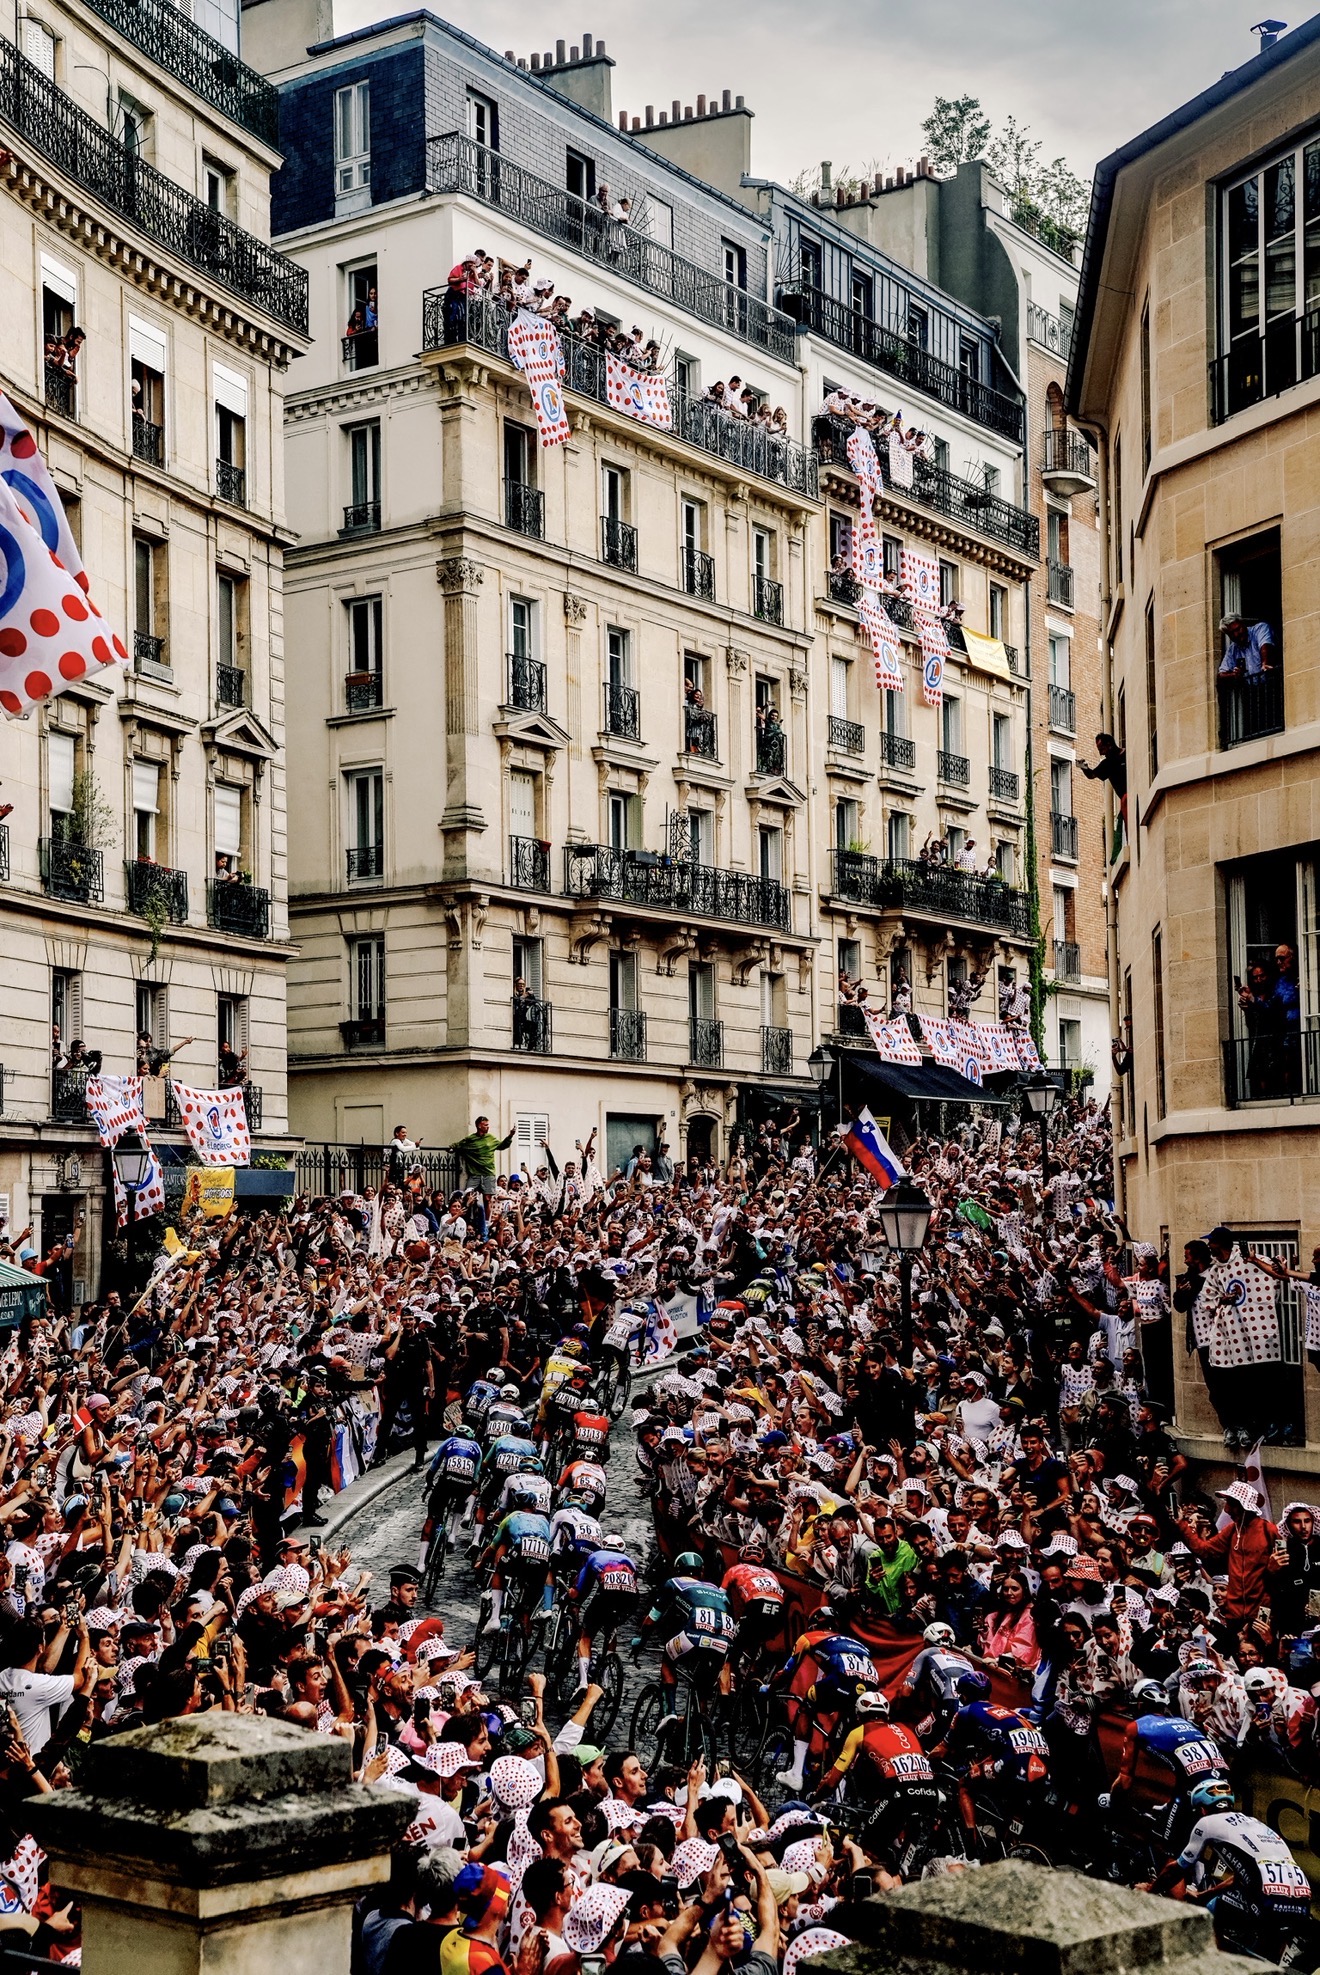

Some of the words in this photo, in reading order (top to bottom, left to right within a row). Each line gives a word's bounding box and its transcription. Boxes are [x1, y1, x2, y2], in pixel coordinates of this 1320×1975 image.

[579, 1525, 592, 1535] 56
[604, 1573, 621, 1584] 208
[756, 1577, 772, 1588] 35
[700, 1609, 712, 1625] 81
[762, 1603, 780, 1616] EF
[1011, 1731, 1034, 1748] 194
[1182, 1745, 1203, 1763] 98
[892, 1755, 918, 1775] 162
[1185, 1760, 1211, 1775] VELUX
[907, 1787, 937, 1798] Cofidis
[867, 1798, 889, 1826] Cofidis
[1167, 1803, 1179, 1829] UNITED
[1163, 1826, 1172, 1841] FDJ
[1220, 1847, 1251, 1885] BAHRAIN
[1266, 1863, 1285, 1884] 57
[1264, 1884, 1291, 1897] VELUX
